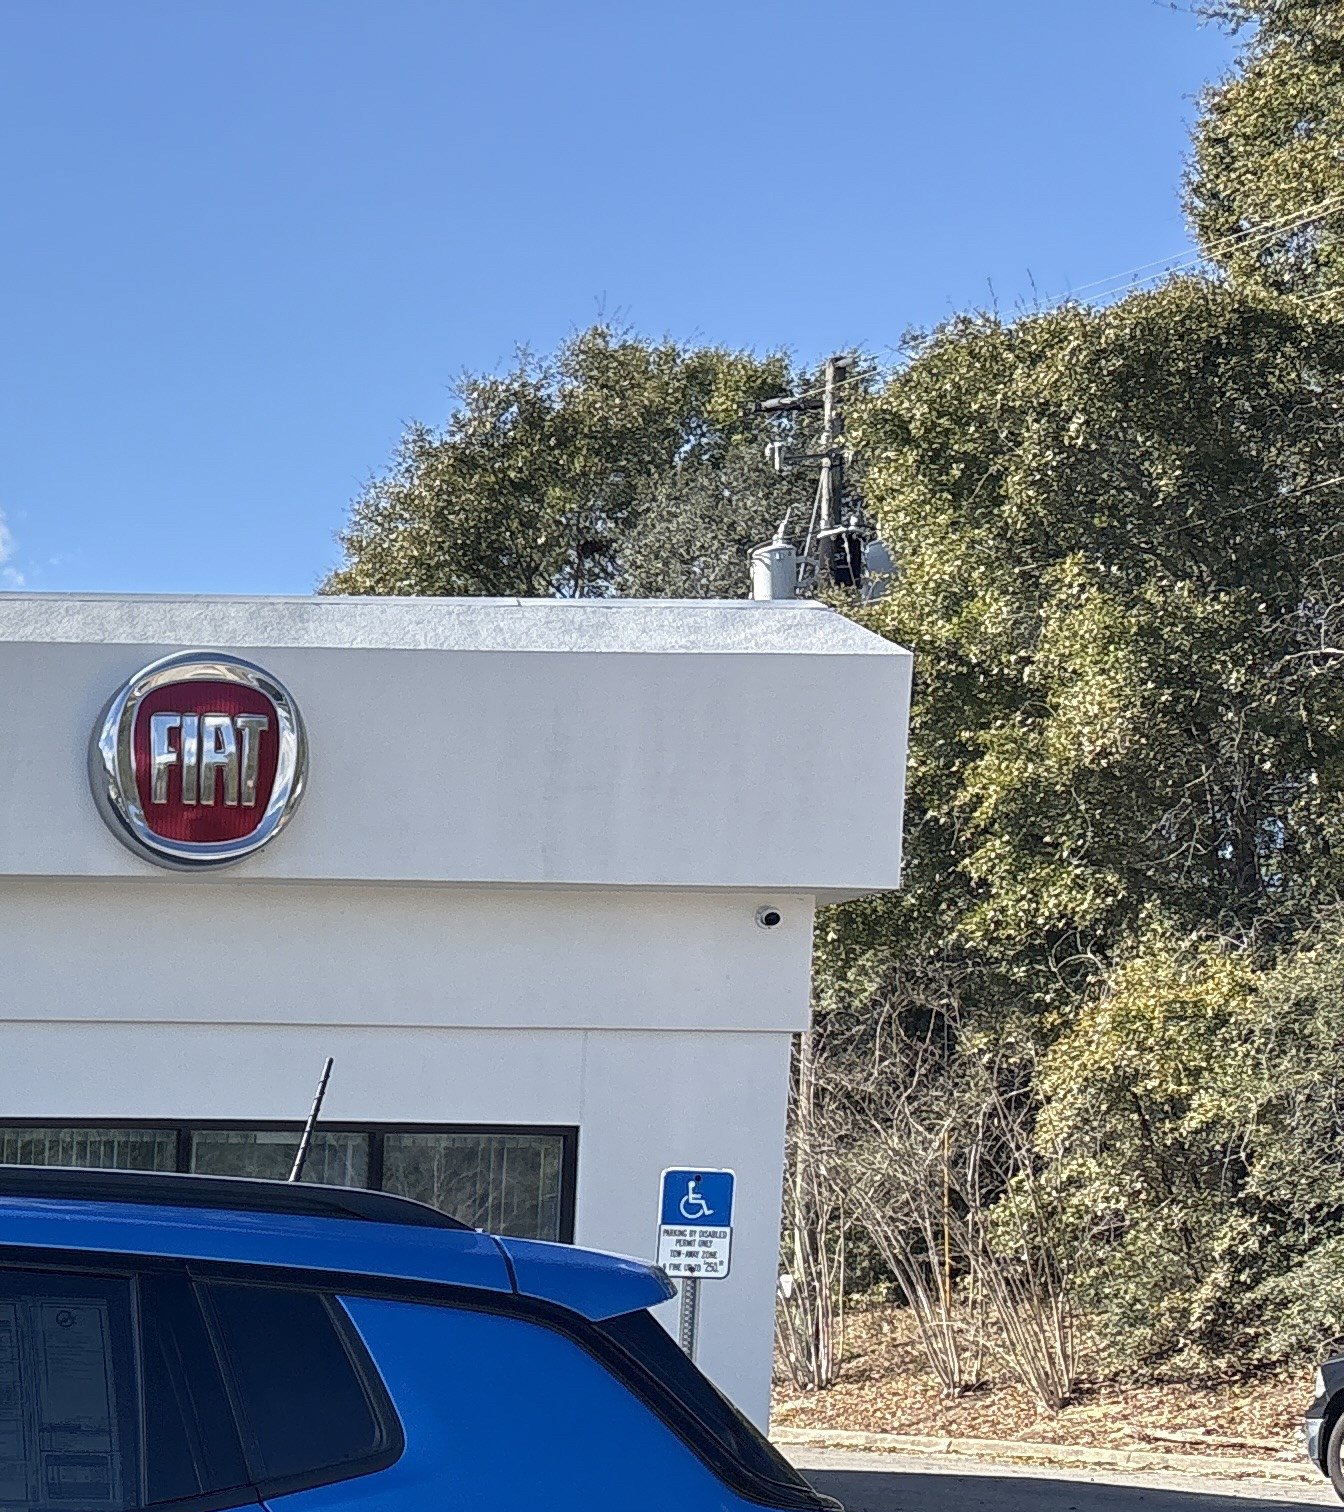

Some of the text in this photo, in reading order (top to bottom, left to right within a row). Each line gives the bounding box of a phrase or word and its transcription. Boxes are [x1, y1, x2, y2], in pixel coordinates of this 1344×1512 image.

[149, 712, 269, 807] FIAT
[663, 1229, 687, 1237] PARKING
[699, 1230, 727, 1239] DISABLED
